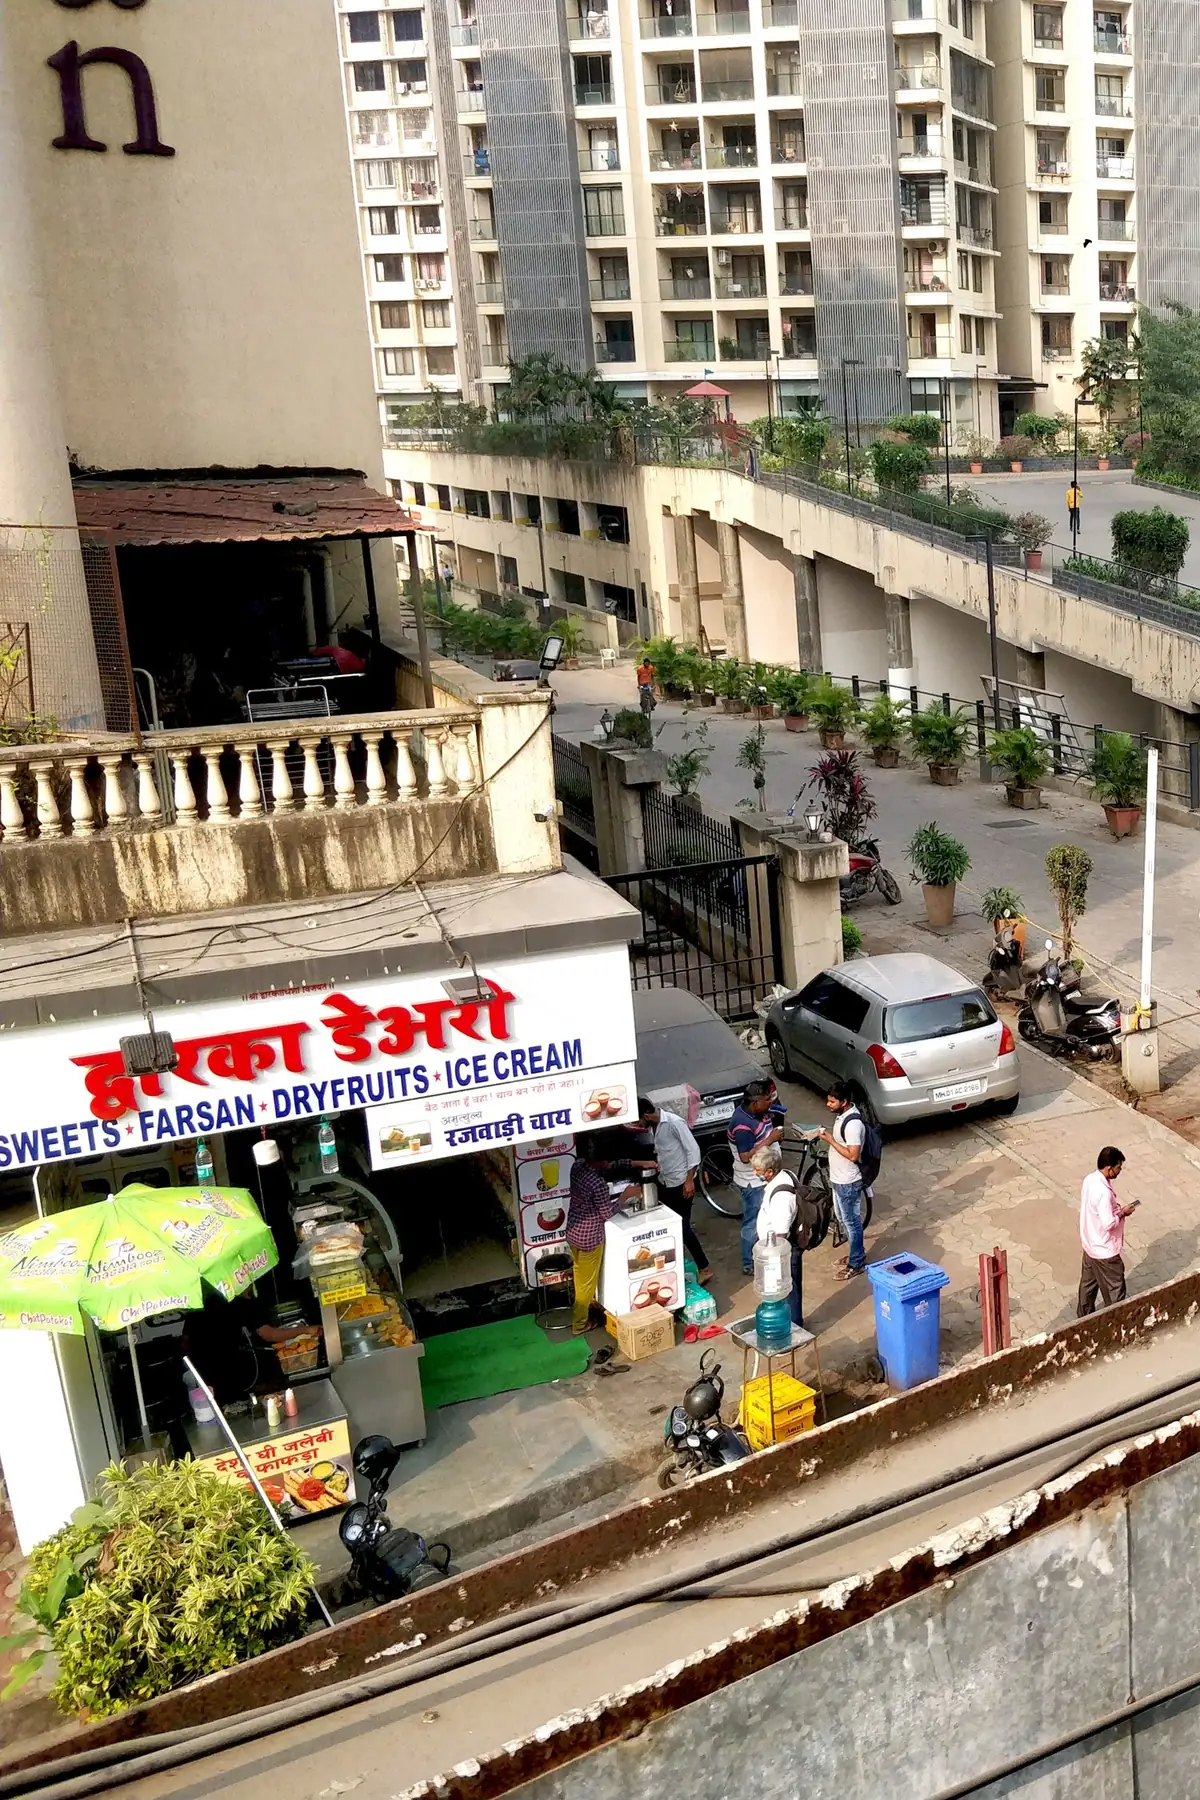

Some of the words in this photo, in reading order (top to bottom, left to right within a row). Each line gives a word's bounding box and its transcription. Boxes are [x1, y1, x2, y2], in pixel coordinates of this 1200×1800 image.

[320, 978, 516, 1063] डेअरी
[0, 1118, 121, 1168] SWEETS
[139, 1093, 256, 1141] FARSAN
[272, 1060, 430, 1119] DRYFRUITS
[445, 1055, 489, 1089] ICE
[493, 1039, 583, 1080] CREAM
[529, 1107, 573, 1131] चाय
[283, 1427, 335, 1452] जलेबी
